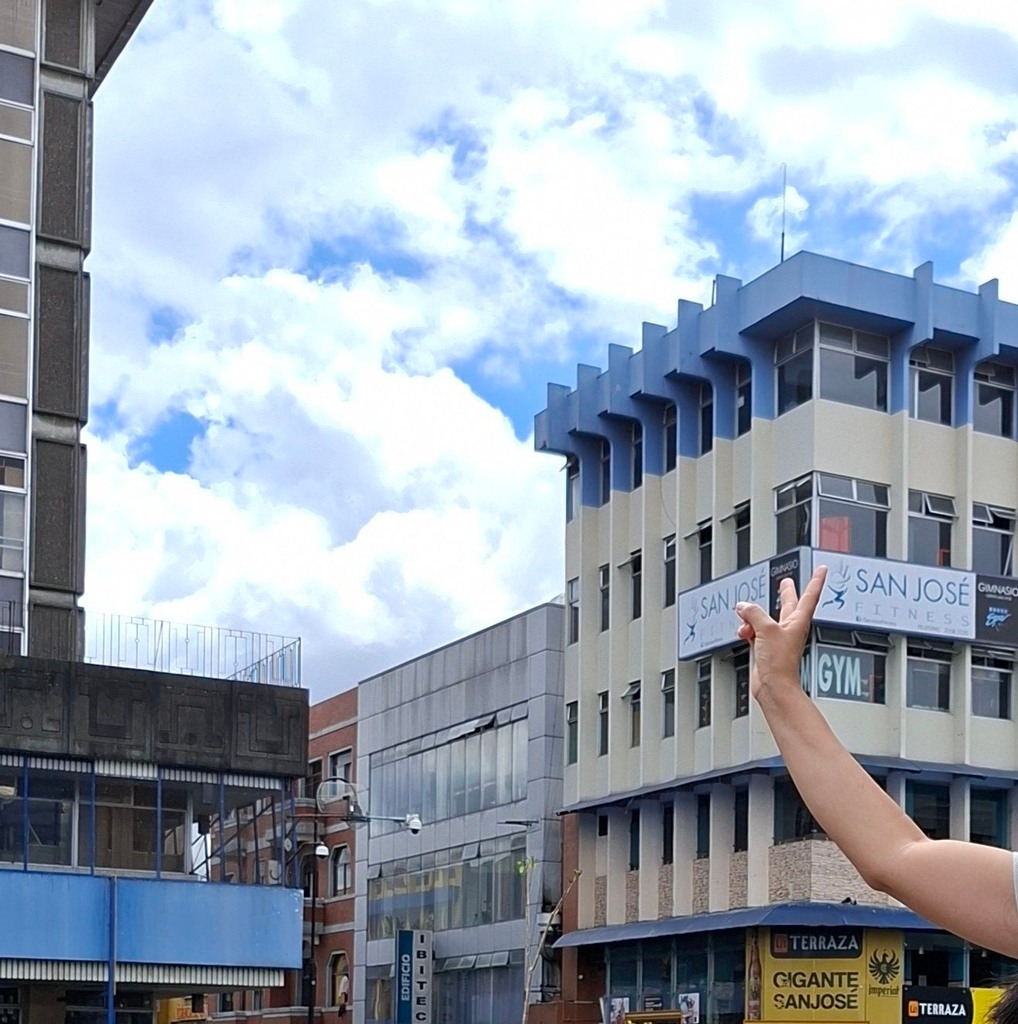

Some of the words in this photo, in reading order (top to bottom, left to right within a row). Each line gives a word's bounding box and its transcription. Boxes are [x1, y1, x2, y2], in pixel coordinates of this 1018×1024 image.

[701, 585, 729, 619] SAN
[732, 568, 767, 611] JOSÉ
[856, 568, 907, 600] SAN
[914, 577, 970, 607] JOSÉ
[855, 601, 970, 627] FITNESS
[818, 653, 861, 697] GYM
[789, 935, 859, 951] TERRAZA
[401, 953, 411, 1001] EDIFICIO
[415, 934, 427, 1021] IBITEC
[773, 971, 859, 989] GIGANTE
[919, 1002, 967, 1016] TERRAZA
